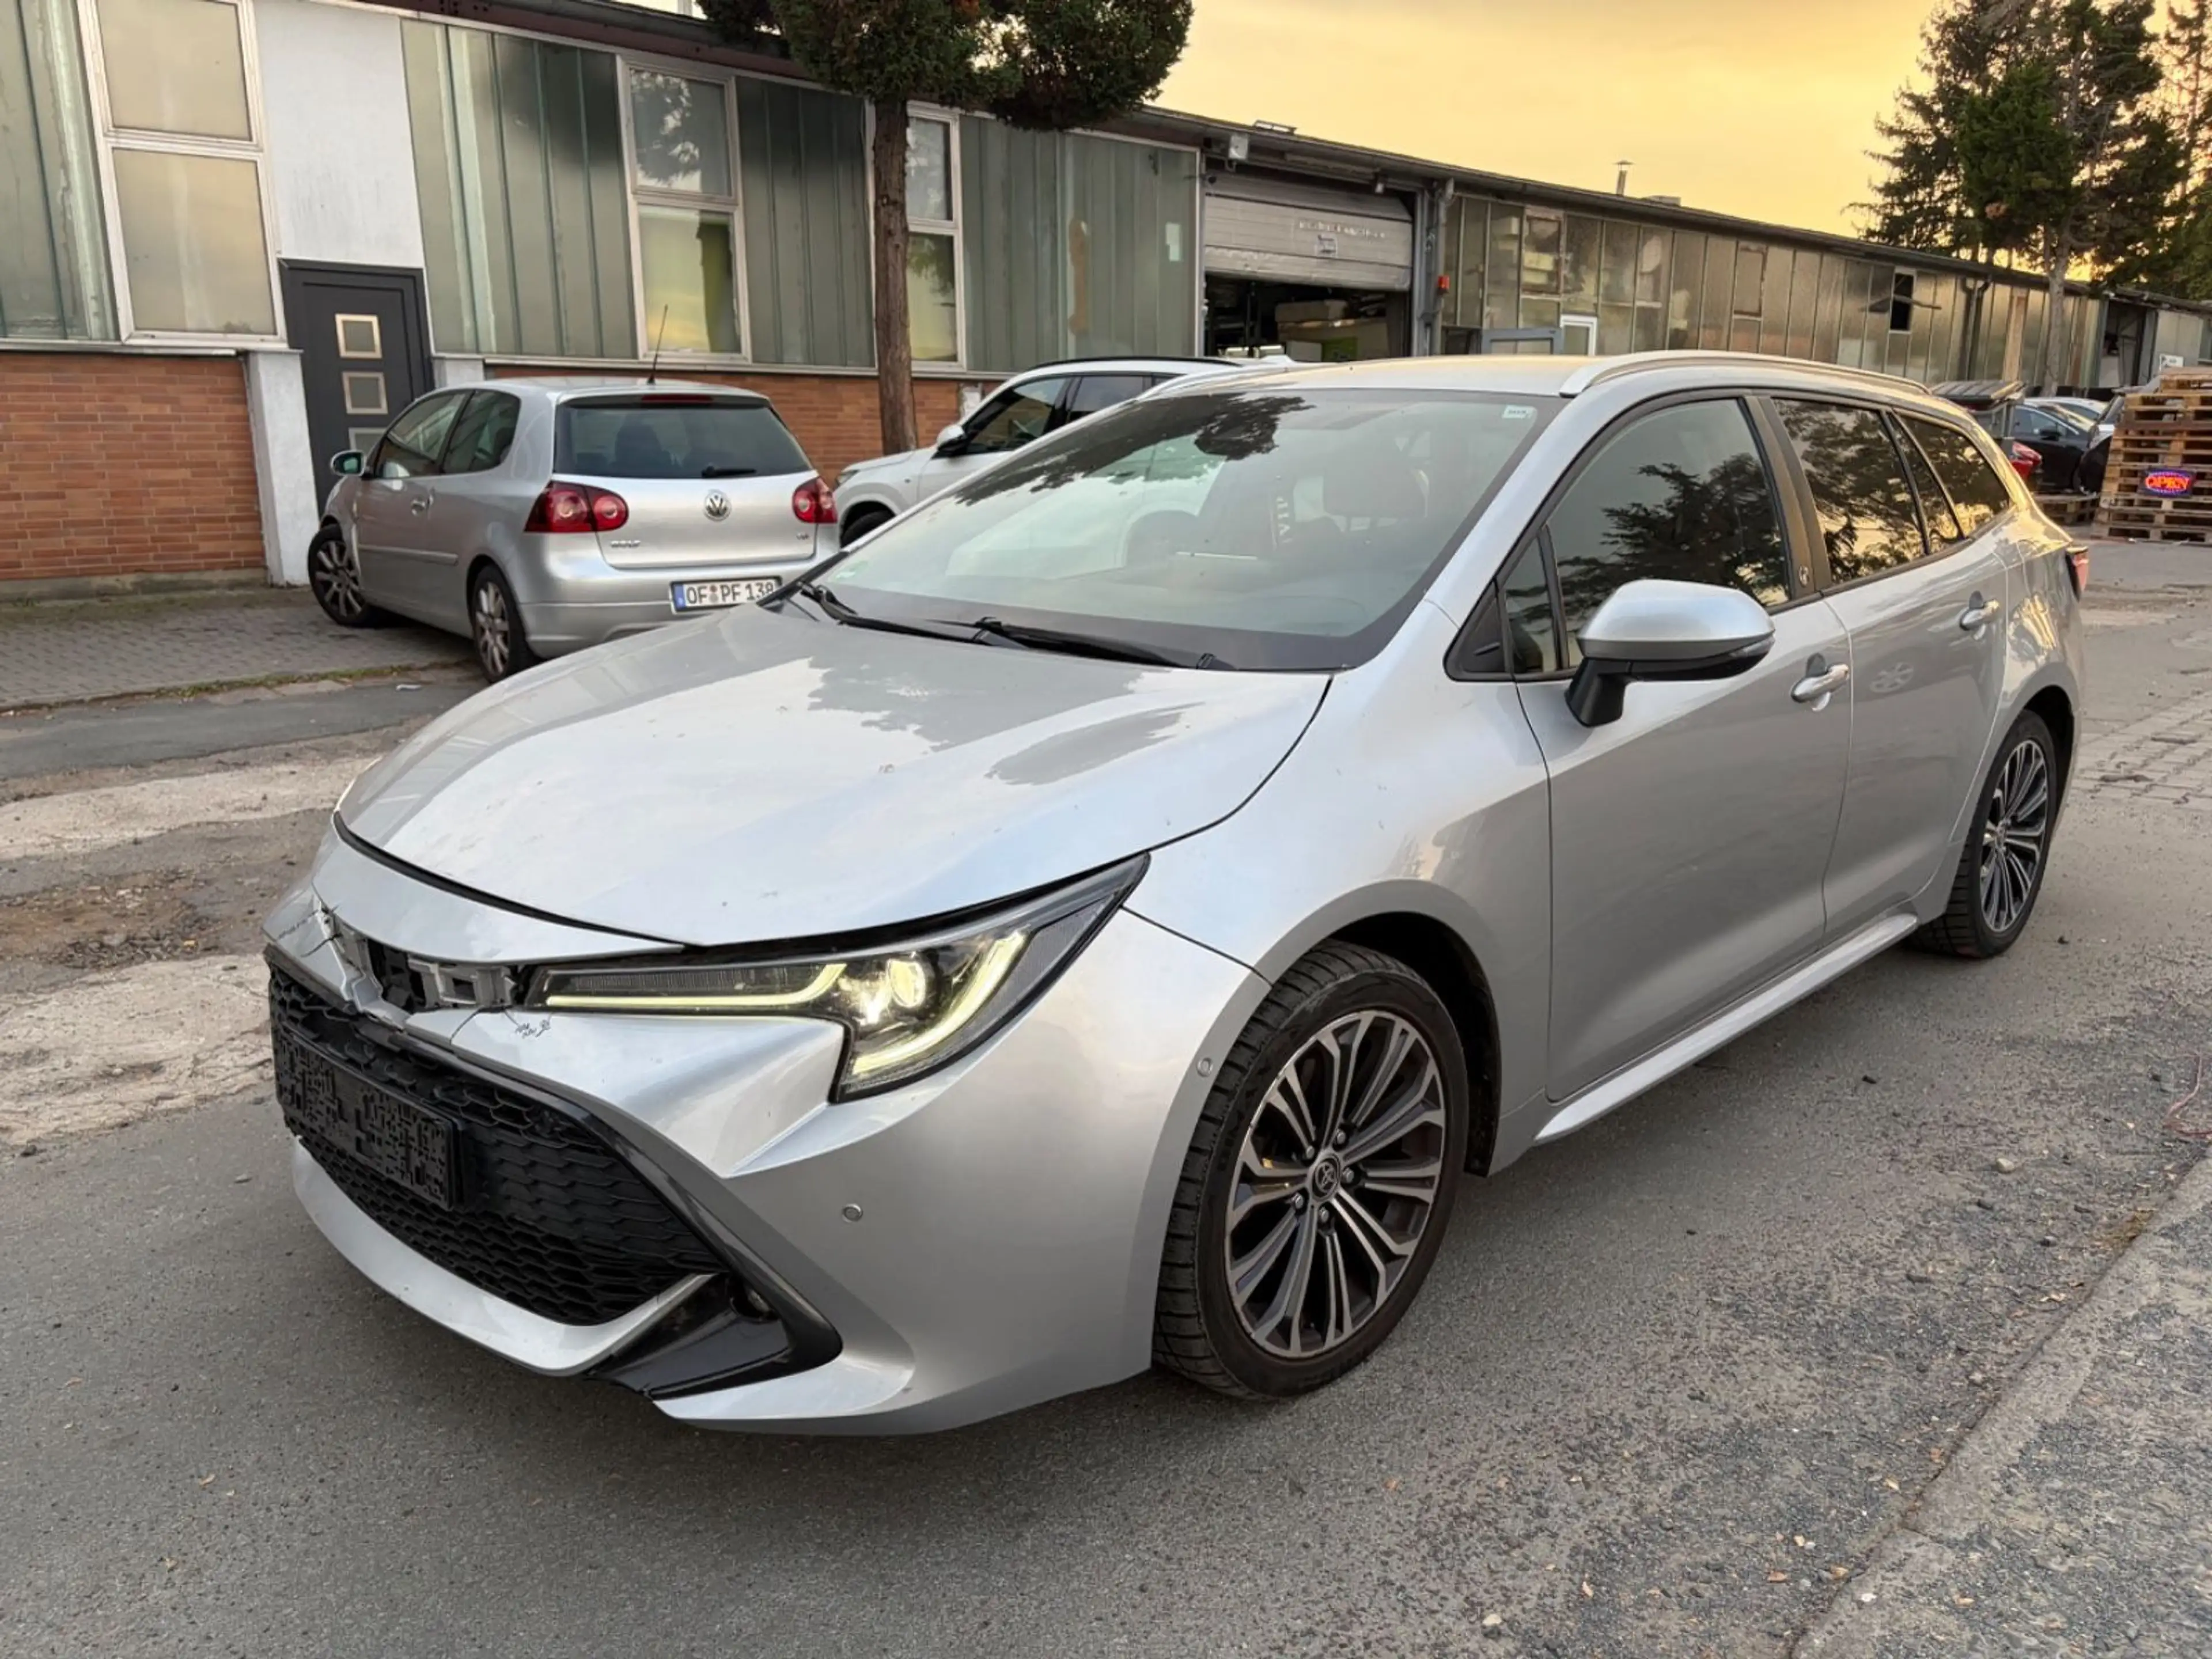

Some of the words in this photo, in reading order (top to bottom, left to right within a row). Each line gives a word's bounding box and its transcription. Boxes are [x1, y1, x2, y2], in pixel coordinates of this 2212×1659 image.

[2145, 476, 2189, 490] OPEN
[686, 585, 708, 604] OF
[720, 584, 741, 602] PF
